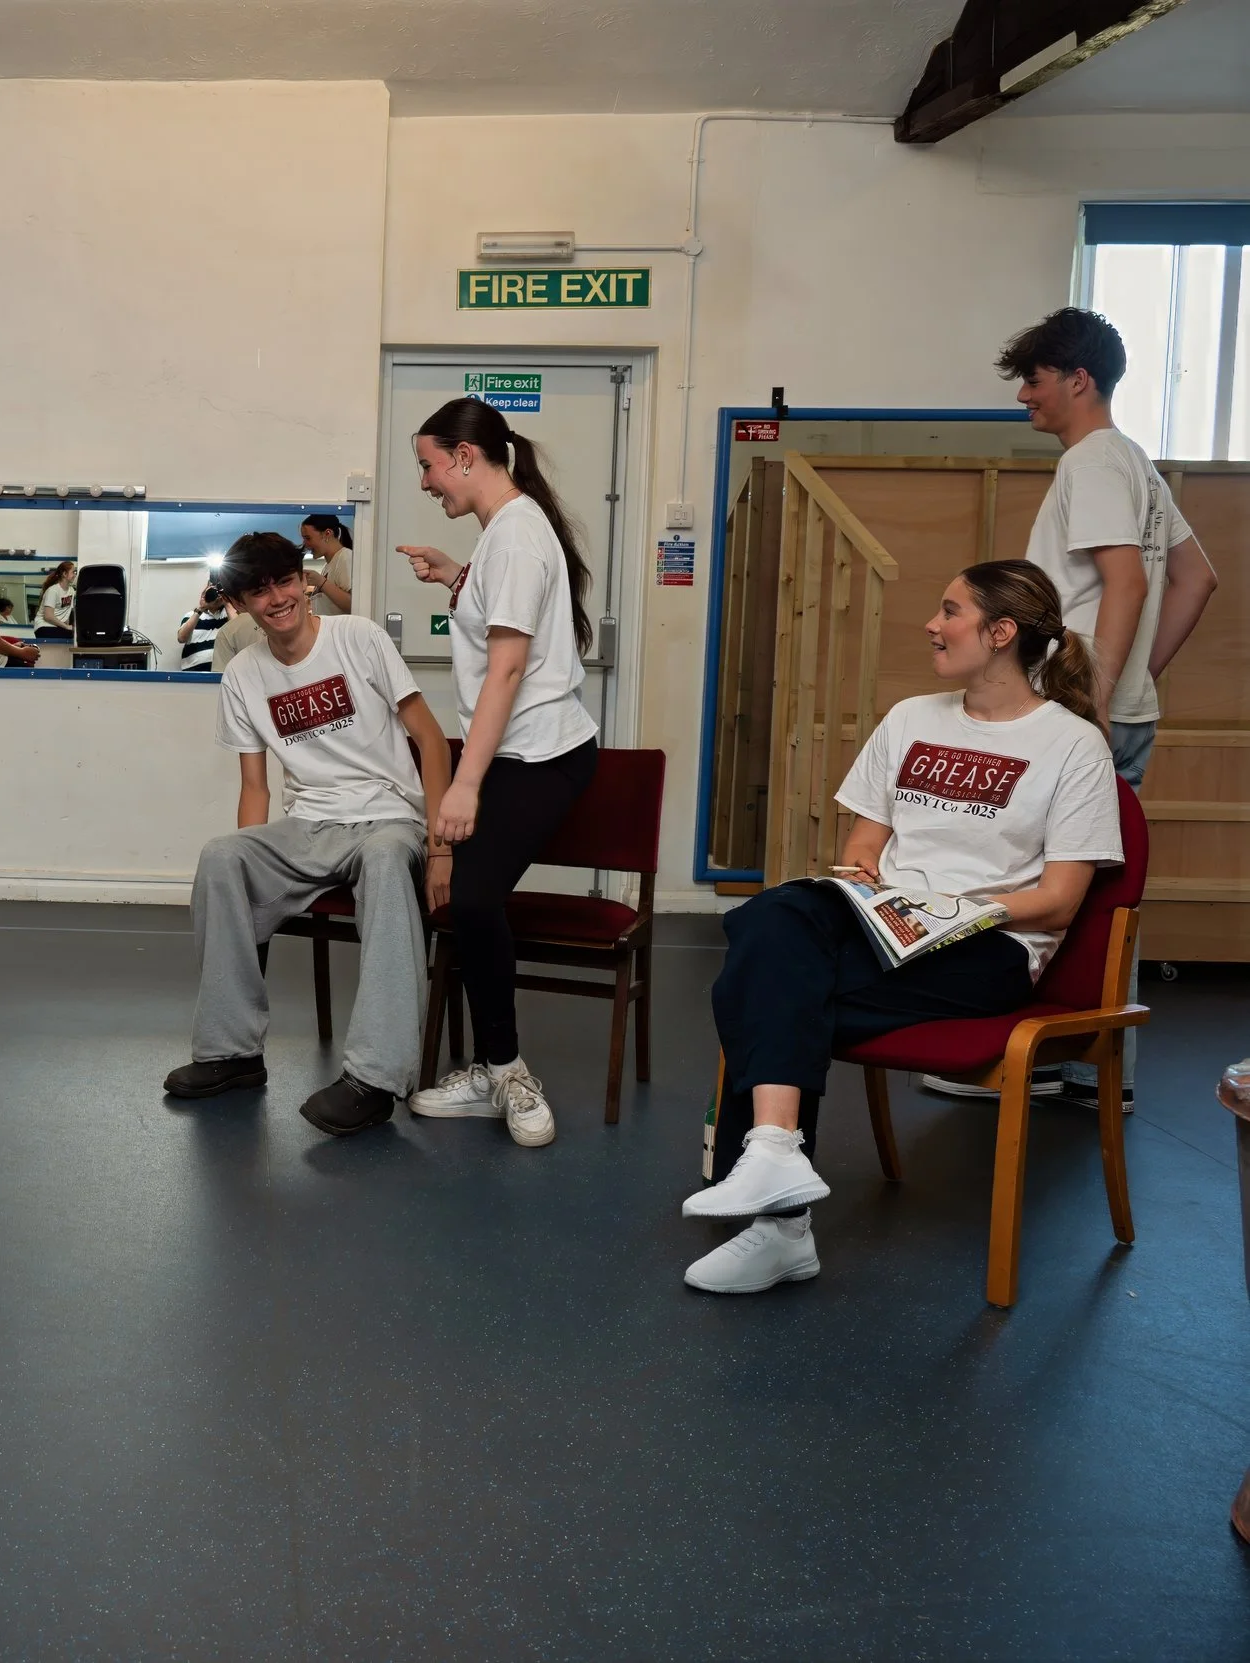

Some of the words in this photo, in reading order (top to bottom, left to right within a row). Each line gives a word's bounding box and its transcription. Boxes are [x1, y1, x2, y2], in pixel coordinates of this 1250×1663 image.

[469, 275, 548, 304] FIRE
[561, 273, 642, 302] EXIT
[487, 377, 511, 388] Fire
[514, 377, 539, 388] exit
[486, 398, 511, 408] Keep
[513, 398, 538, 407] clear
[277, 686, 346, 725] GREASE
[330, 717, 354, 731] 2025
[938, 749, 949, 758] WE
[951, 752, 961, 760] GO
[963, 754, 1002, 767] TOGETHER
[910, 755, 1015, 792] GREASE
[941, 788, 982, 799] MUSICAL
[895, 790, 958, 813] DOSYTCo
[963, 803, 998, 819] 2025
